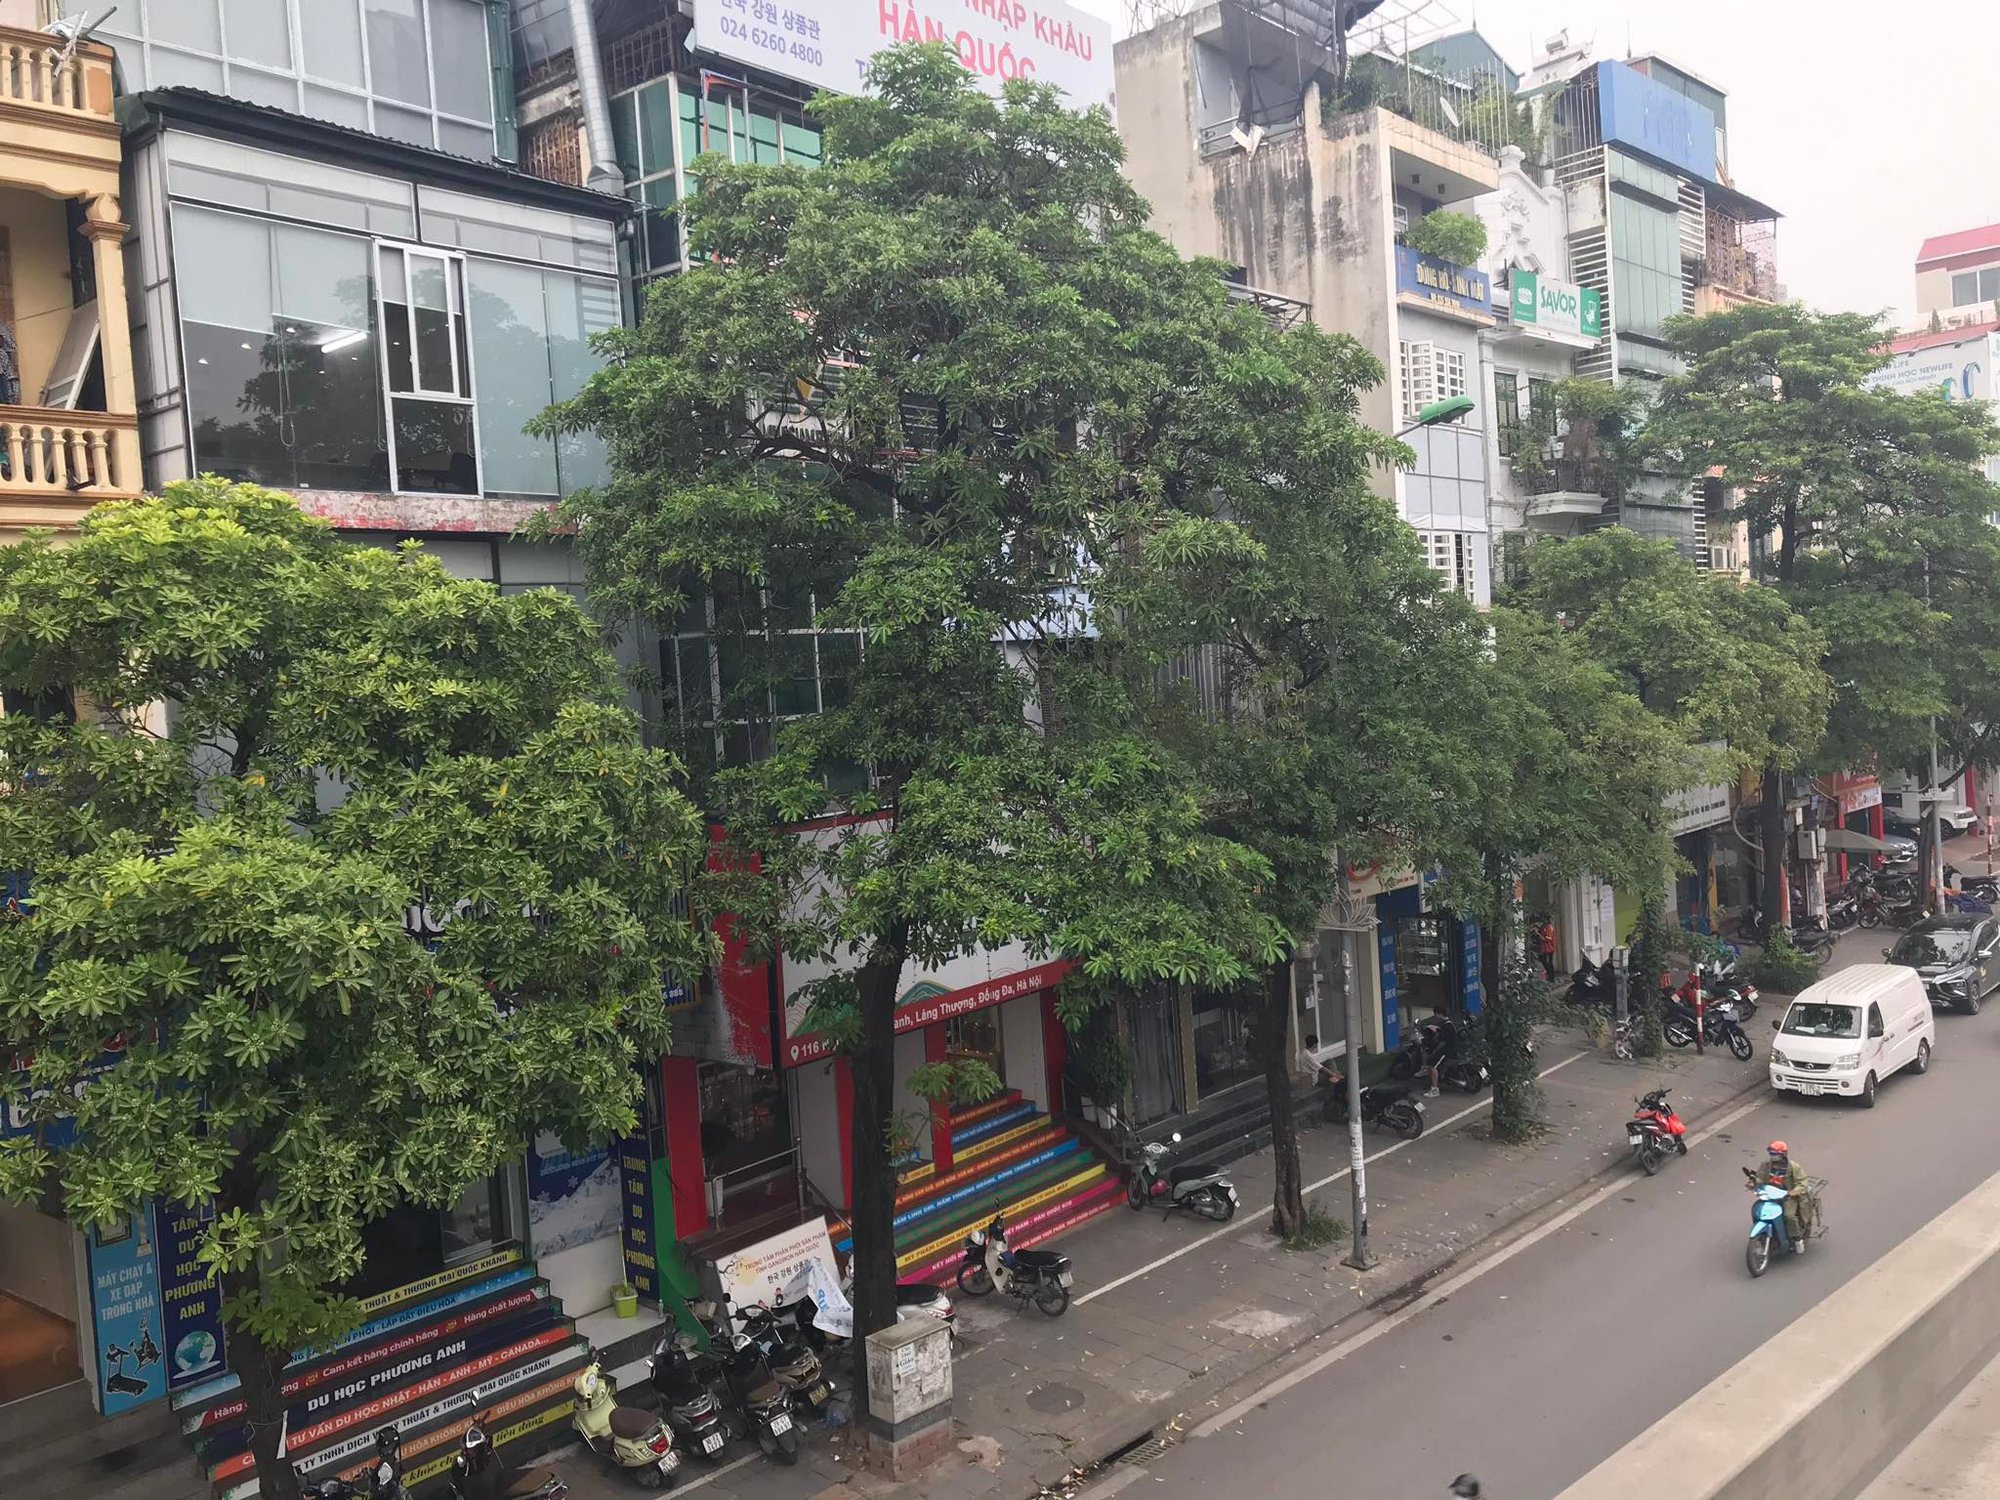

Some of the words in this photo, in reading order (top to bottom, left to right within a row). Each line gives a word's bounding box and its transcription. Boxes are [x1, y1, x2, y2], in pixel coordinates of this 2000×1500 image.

[782, 9, 820, 40] 상품관
[879, 0, 943, 43] HÀN
[1033, 12, 1092, 61] KHẨU
[720, 16, 748, 40] 024
[752, 28, 787, 53] 6260
[790, 42, 823, 67] 4800
[1541, 285, 1577, 319] SAVOR
[1920, 362, 1953, 374] NEWLIFE
[802, 1042, 819, 1057] 116
[915, 1008, 938, 1023] Láng
[939, 998, 977, 1018] Thượng,
[1002, 983, 1015, 997] Đa,
[1017, 977, 1028, 991] Hà
[1029, 974, 1042, 989] Nội
[119, 1264, 145, 1285] CHẠY
[745, 1260, 763, 1271] TRUNG
[763, 1253, 774, 1263] TÂM
[110, 1286, 123, 1301] XE
[164, 1278, 216, 1302] PHƯƠNG
[403, 1278, 437, 1297] THƯƠNG
[101, 1302, 133, 1322] TRONG
[179, 1301, 205, 1321] ANH
[214, 1403, 243, 1420] Hàng
[322, 1363, 345, 1378] Cam
[346, 1356, 363, 1369] kết
[364, 1347, 388, 1362] hàng
[389, 1336, 415, 1350] chính
[415, 1328, 439, 1343] hàng
[464, 1309, 487, 1324] Hàng
[488, 1301, 507, 1315] chất
[508, 1293, 531, 1308] lượng
[308, 1394, 330, 1412] DU
[334, 1380, 367, 1402] HỌC
[370, 1353, 432, 1387] PHƯƠNG
[436, 1340, 467, 1361] ANH
[291, 1434, 305, 1446] TƯ
[309, 1421, 333, 1438] VẤN
[335, 1415, 352, 1428] DU
[354, 1404, 380, 1420] HỌC
[382, 1390, 410, 1407] NHẬT
[418, 1376, 441, 1392] HÀN
[449, 1366, 471, 1380] ANH
[479, 1355, 494, 1369] MỸ
[501, 1338, 549, 1360] CANADA...
[319, 1446, 345, 1463] TNHH
[347, 1437, 371, 1452] DỊCH
[402, 1407, 431, 1425] THUẬT
[433, 1405, 440, 1415] &
[430, 1424, 462, 1444] KHÔNG
